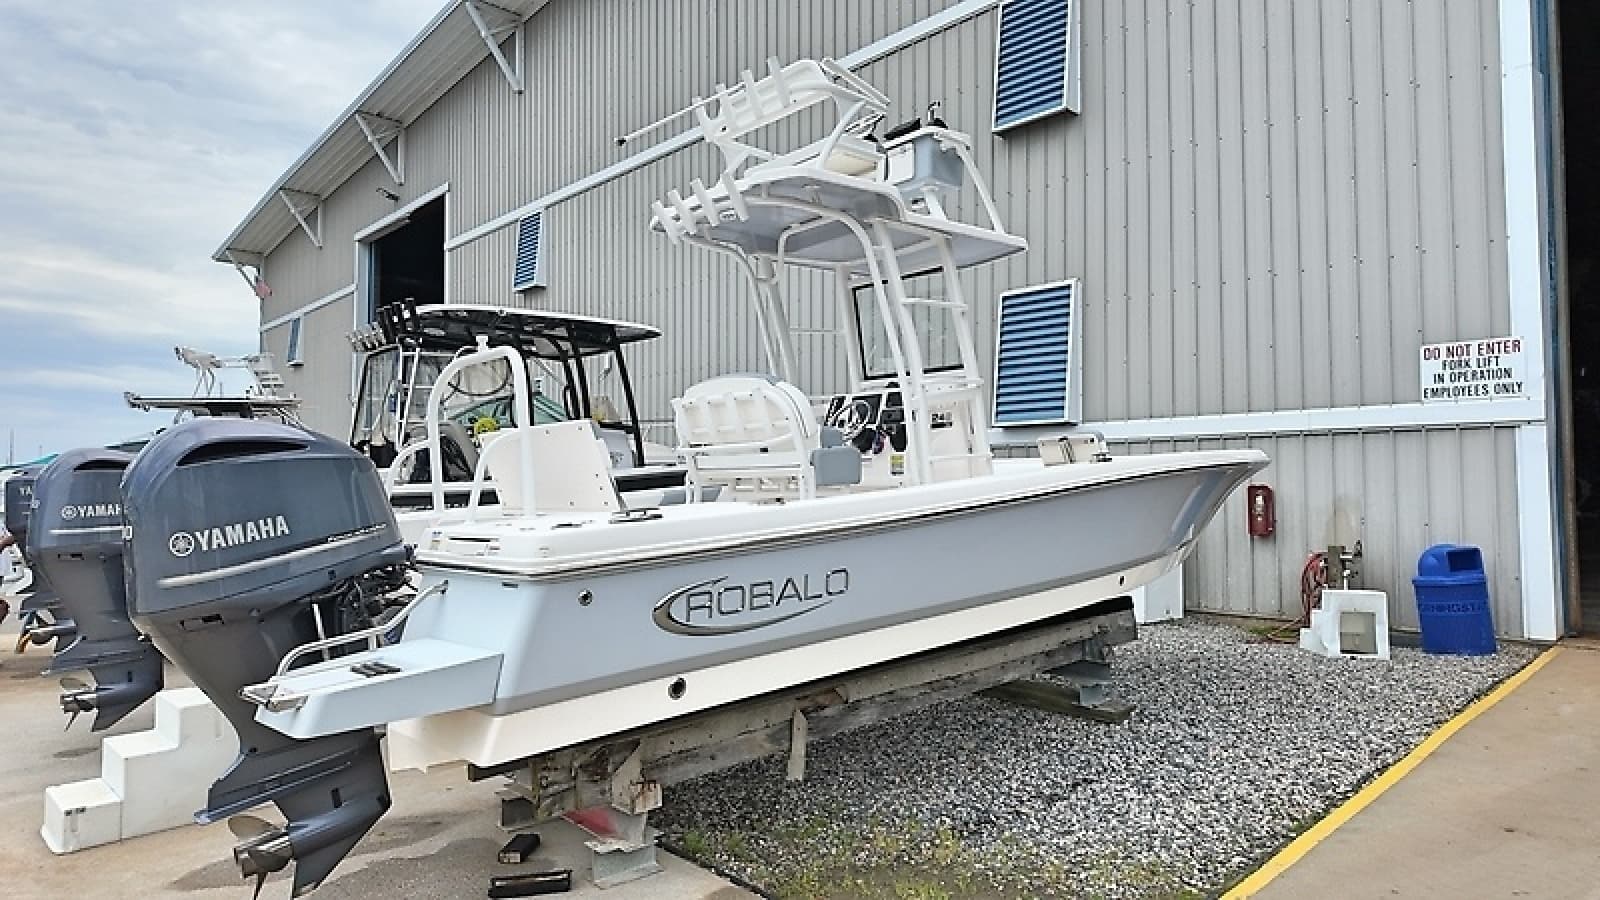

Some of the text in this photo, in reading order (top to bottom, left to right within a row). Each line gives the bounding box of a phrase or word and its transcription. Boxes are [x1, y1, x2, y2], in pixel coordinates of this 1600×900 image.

[1423, 339, 1521, 361] DO NOT ENTER
[1441, 355, 1501, 371] FORK LIFT
[1433, 367, 1513, 385] IN OPERATION
[1423, 381, 1523, 399] EMPLOYEES ONLY
[194, 515, 289, 552] YAMAHA
[685, 567, 849, 623] ROBALO
